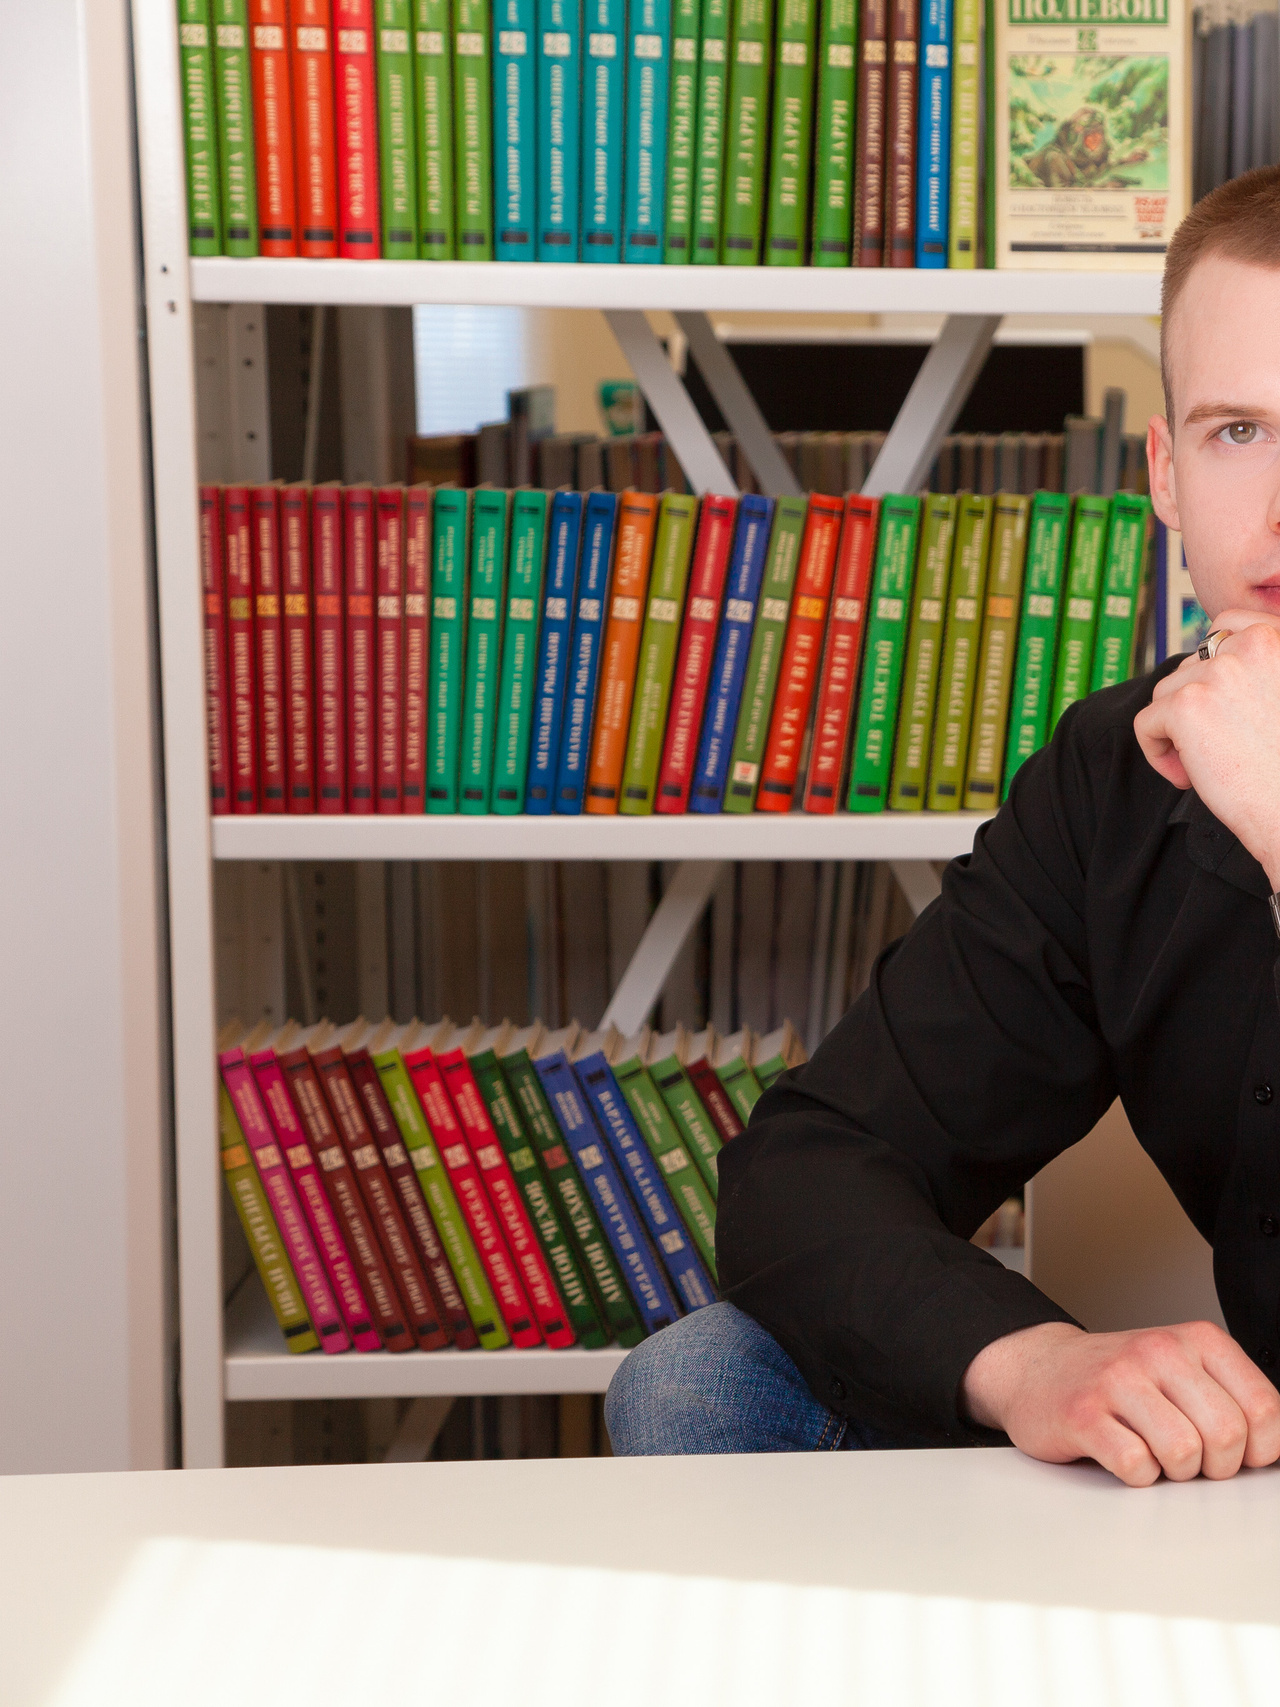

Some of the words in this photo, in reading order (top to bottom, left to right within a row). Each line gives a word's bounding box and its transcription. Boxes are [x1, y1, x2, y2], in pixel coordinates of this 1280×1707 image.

[188, 54, 208, 140] ИЛЬИНА
[225, 55, 244, 142] ИЛЬИНА
[673, 75, 692, 157] КРЫЛОВ
[702, 76, 722, 158] КРЫЛОВ
[739, 96, 757, 166] ЛАРРИ
[957, 79, 975, 155] ОЛЕША
[783, 97, 801, 168] ЛАРРИ
[830, 100, 849, 170] ЛАРРИ
[193, 151, 211, 219] ЕЛЕНА
[229, 152, 247, 220] ЕЛЕНА
[348, 153, 364, 218] ФАЗИЛЬ
[671, 167, 691, 222] ИВАН
[700, 168, 718, 223] ИВАН
[736, 177, 752, 205] ЯН
[780, 178, 798, 206] ЯН
[828, 179, 845, 208] ЯН
[957, 166, 974, 227] ЮРИЙ
[787, 633, 814, 691] ТВЕН
[828, 634, 853, 693] ТВЕН
[870, 640, 894, 722] ТОЛСТОЙ
[911, 639, 934, 717] ТУРГЕНЕВ
[948, 638, 970, 716] ТУРГЕНЕВ
[983, 631, 1006, 716] ТУРГЕНЕВ
[1022, 637, 1045, 716] ТОЛСТОЙ
[1060, 640, 1084, 704] ОЛСТОЙ
[537, 698, 554, 769] АНАТОЛИЙ
[567, 699, 585, 769] АНАТОЛИЙ
[669, 688, 696, 774] ДЖОНАТАН
[685, 634, 704, 684] СВИФТ
[774, 707, 801, 769] МАРК
[817, 708, 842, 770] МАРК
[864, 730, 883, 765] ЛЕВ
[906, 724, 925, 767] ИВАН
[942, 723, 962, 767] ИВАН
[976, 724, 996, 773] ИВАН
[598, 1090, 634, 1148] ВАРЛАМ
[625, 1150, 668, 1225] ШАЛАМОВ
[235, 1177, 279, 1263] ТУРГЕНЕВ
[269, 1174, 309, 1260] УСПЕНСКИЙ
[300, 1174, 341, 1259] УСПЕНСКИЙ
[398, 1175, 440, 1259] ФОНВИЗИН
[460, 1178, 497, 1249] ЧАРСКАЯ
[492, 1180, 529, 1250] ЧАРСКАЯ
[524, 1180, 559, 1241] ЧЕХОВ
[558, 1178, 594, 1239] ЧЕХОВ
[594, 1174, 635, 1250] ШАЛАМОВ
[267, 1268, 299, 1316] ИВАН
[432, 1263, 464, 1310] ДЕНИС
[488, 1252, 521, 1306] ЛИДИЯ
[520, 1253, 552, 1307] ЛИДИЯ
[548, 1244, 588, 1307] АНТОН
[582, 1242, 624, 1304] АНТОН
[626, 1251, 662, 1309] ВАРЛАМ
